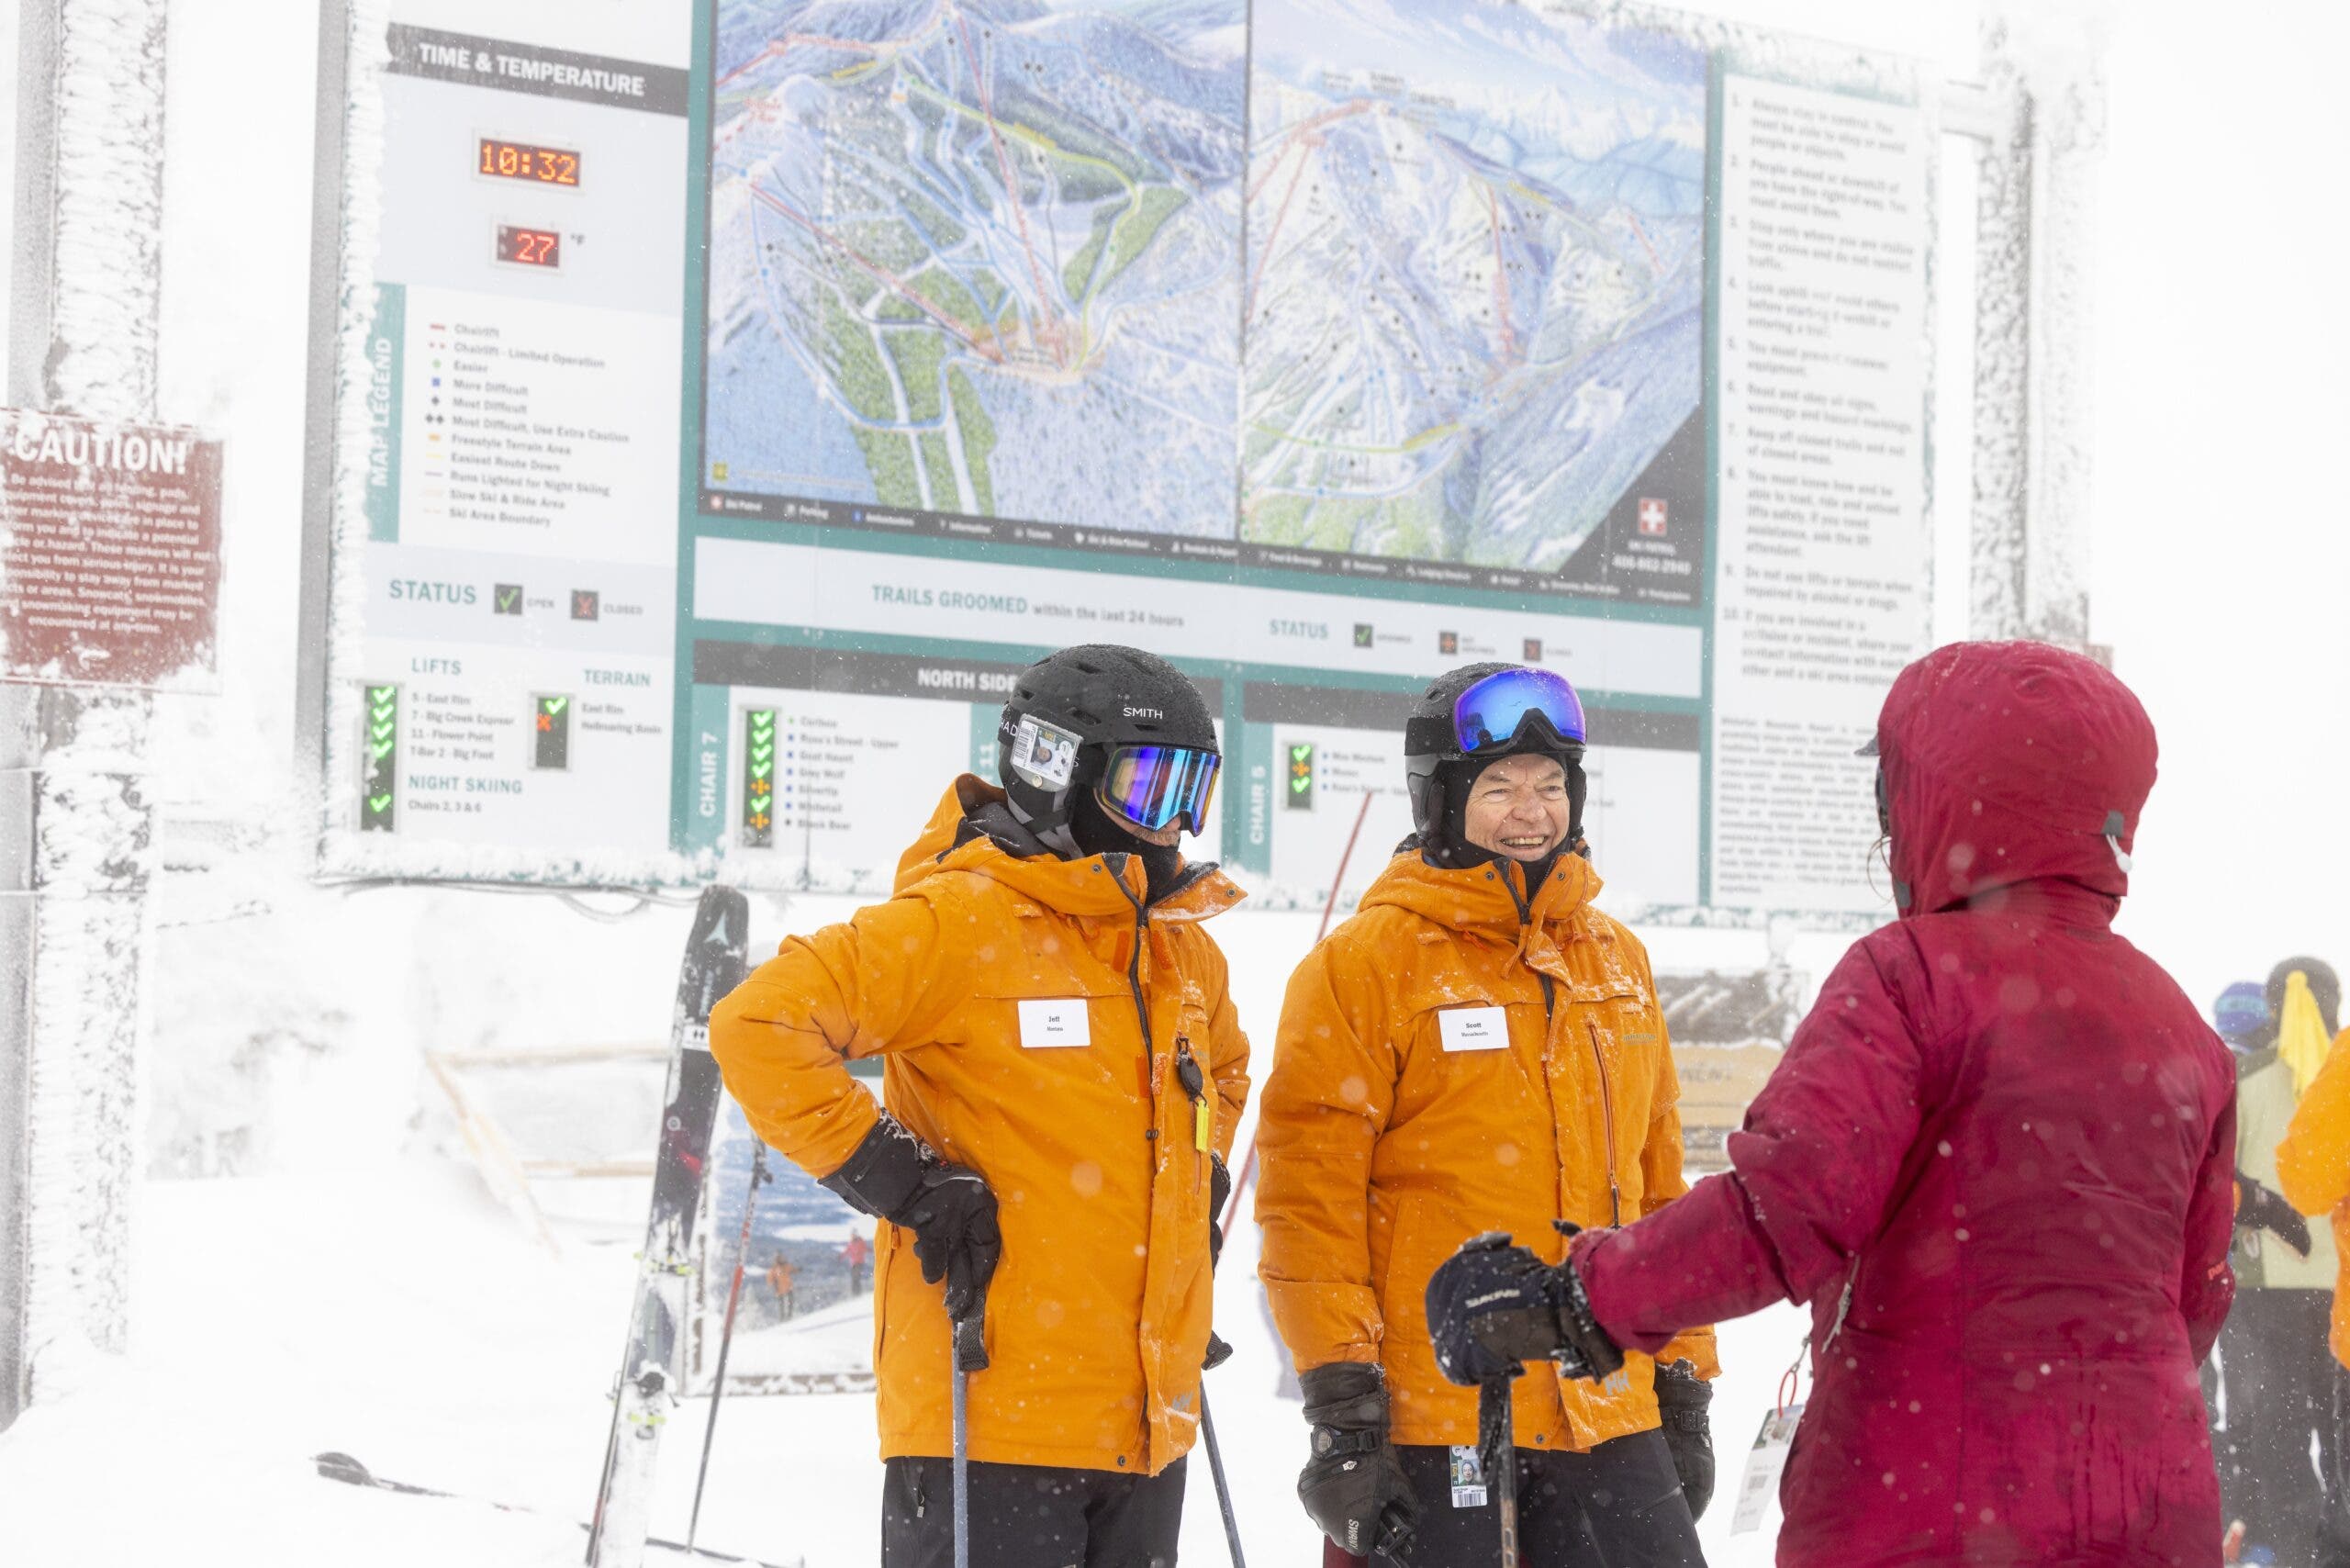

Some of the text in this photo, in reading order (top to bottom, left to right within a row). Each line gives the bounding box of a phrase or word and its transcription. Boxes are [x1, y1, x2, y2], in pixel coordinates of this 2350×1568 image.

[420, 42, 645, 96] TIME & TEMPERATURE
[482, 144, 576, 184] 10:32
[517, 233, 555, 262] 27
[454, 324, 498, 338] Chairlift
[454, 342, 605, 369] Chairlift Limited Operation
[453, 361, 487, 373] Easier
[373, 338, 392, 428] LEGEND
[453, 379, 528, 396] More Difficult
[453, 398, 526, 413] Most Difficult
[453, 416, 630, 442] Most Difficult, Use Extra Caution
[16, 428, 185, 475] CAUTION!
[452, 433, 571, 454] Freestyle Terrain Area
[452, 453, 560, 472] Easiest Route Down
[11, 475, 26, 485] Be
[28, 476, 71, 488] advised
[451, 471, 477, 482] Runs
[482, 474, 521, 488] Lighted
[526, 477, 540, 487] for
[544, 480, 572, 493] Night
[451, 489, 475, 501] Slow
[480, 492, 497, 503] Ski
[512, 495, 536, 507] Ride
[541, 498, 565, 510] Area
[187, 520, 198, 531] to
[450, 508, 550, 528] Ski Area Boundary
[37, 523, 55, 534] you
[30, 554, 50, 566] you
[53, 555, 79, 566] from
[181, 566, 205, 578] your
[64, 571, 75, 581] to
[79, 573, 99, 585] stay
[103, 576, 130, 588] away
[134, 577, 159, 588] from
[389, 579, 476, 604] STATUS
[527, 599, 554, 610] OPEN
[603, 603, 643, 615] CLOSED
[873, 585, 1184, 627] TRAILS GROOMED within the last 24 hours
[28, 613, 95, 630] encountered
[1270, 619, 1328, 640] STATUS
[412, 658, 462, 675] LIFTS
[583, 669, 651, 687] TERRAIN
[918, 668, 1017, 692] NORTH SIDE
[427, 694, 452, 705] East
[453, 696, 472, 706] Rim
[426, 712, 442, 725] Big
[445, 713, 473, 723] Creek
[1124, 707, 1163, 720] SMITH
[431, 730, 464, 741] Flower
[700, 733, 718, 816] CHAIR 7
[408, 776, 522, 793] NIGHT SKIING
[408, 800, 440, 812] Chairs
[1250, 784, 1264, 845] CHAIR
[1348, 1518, 1360, 1550] SWANY
